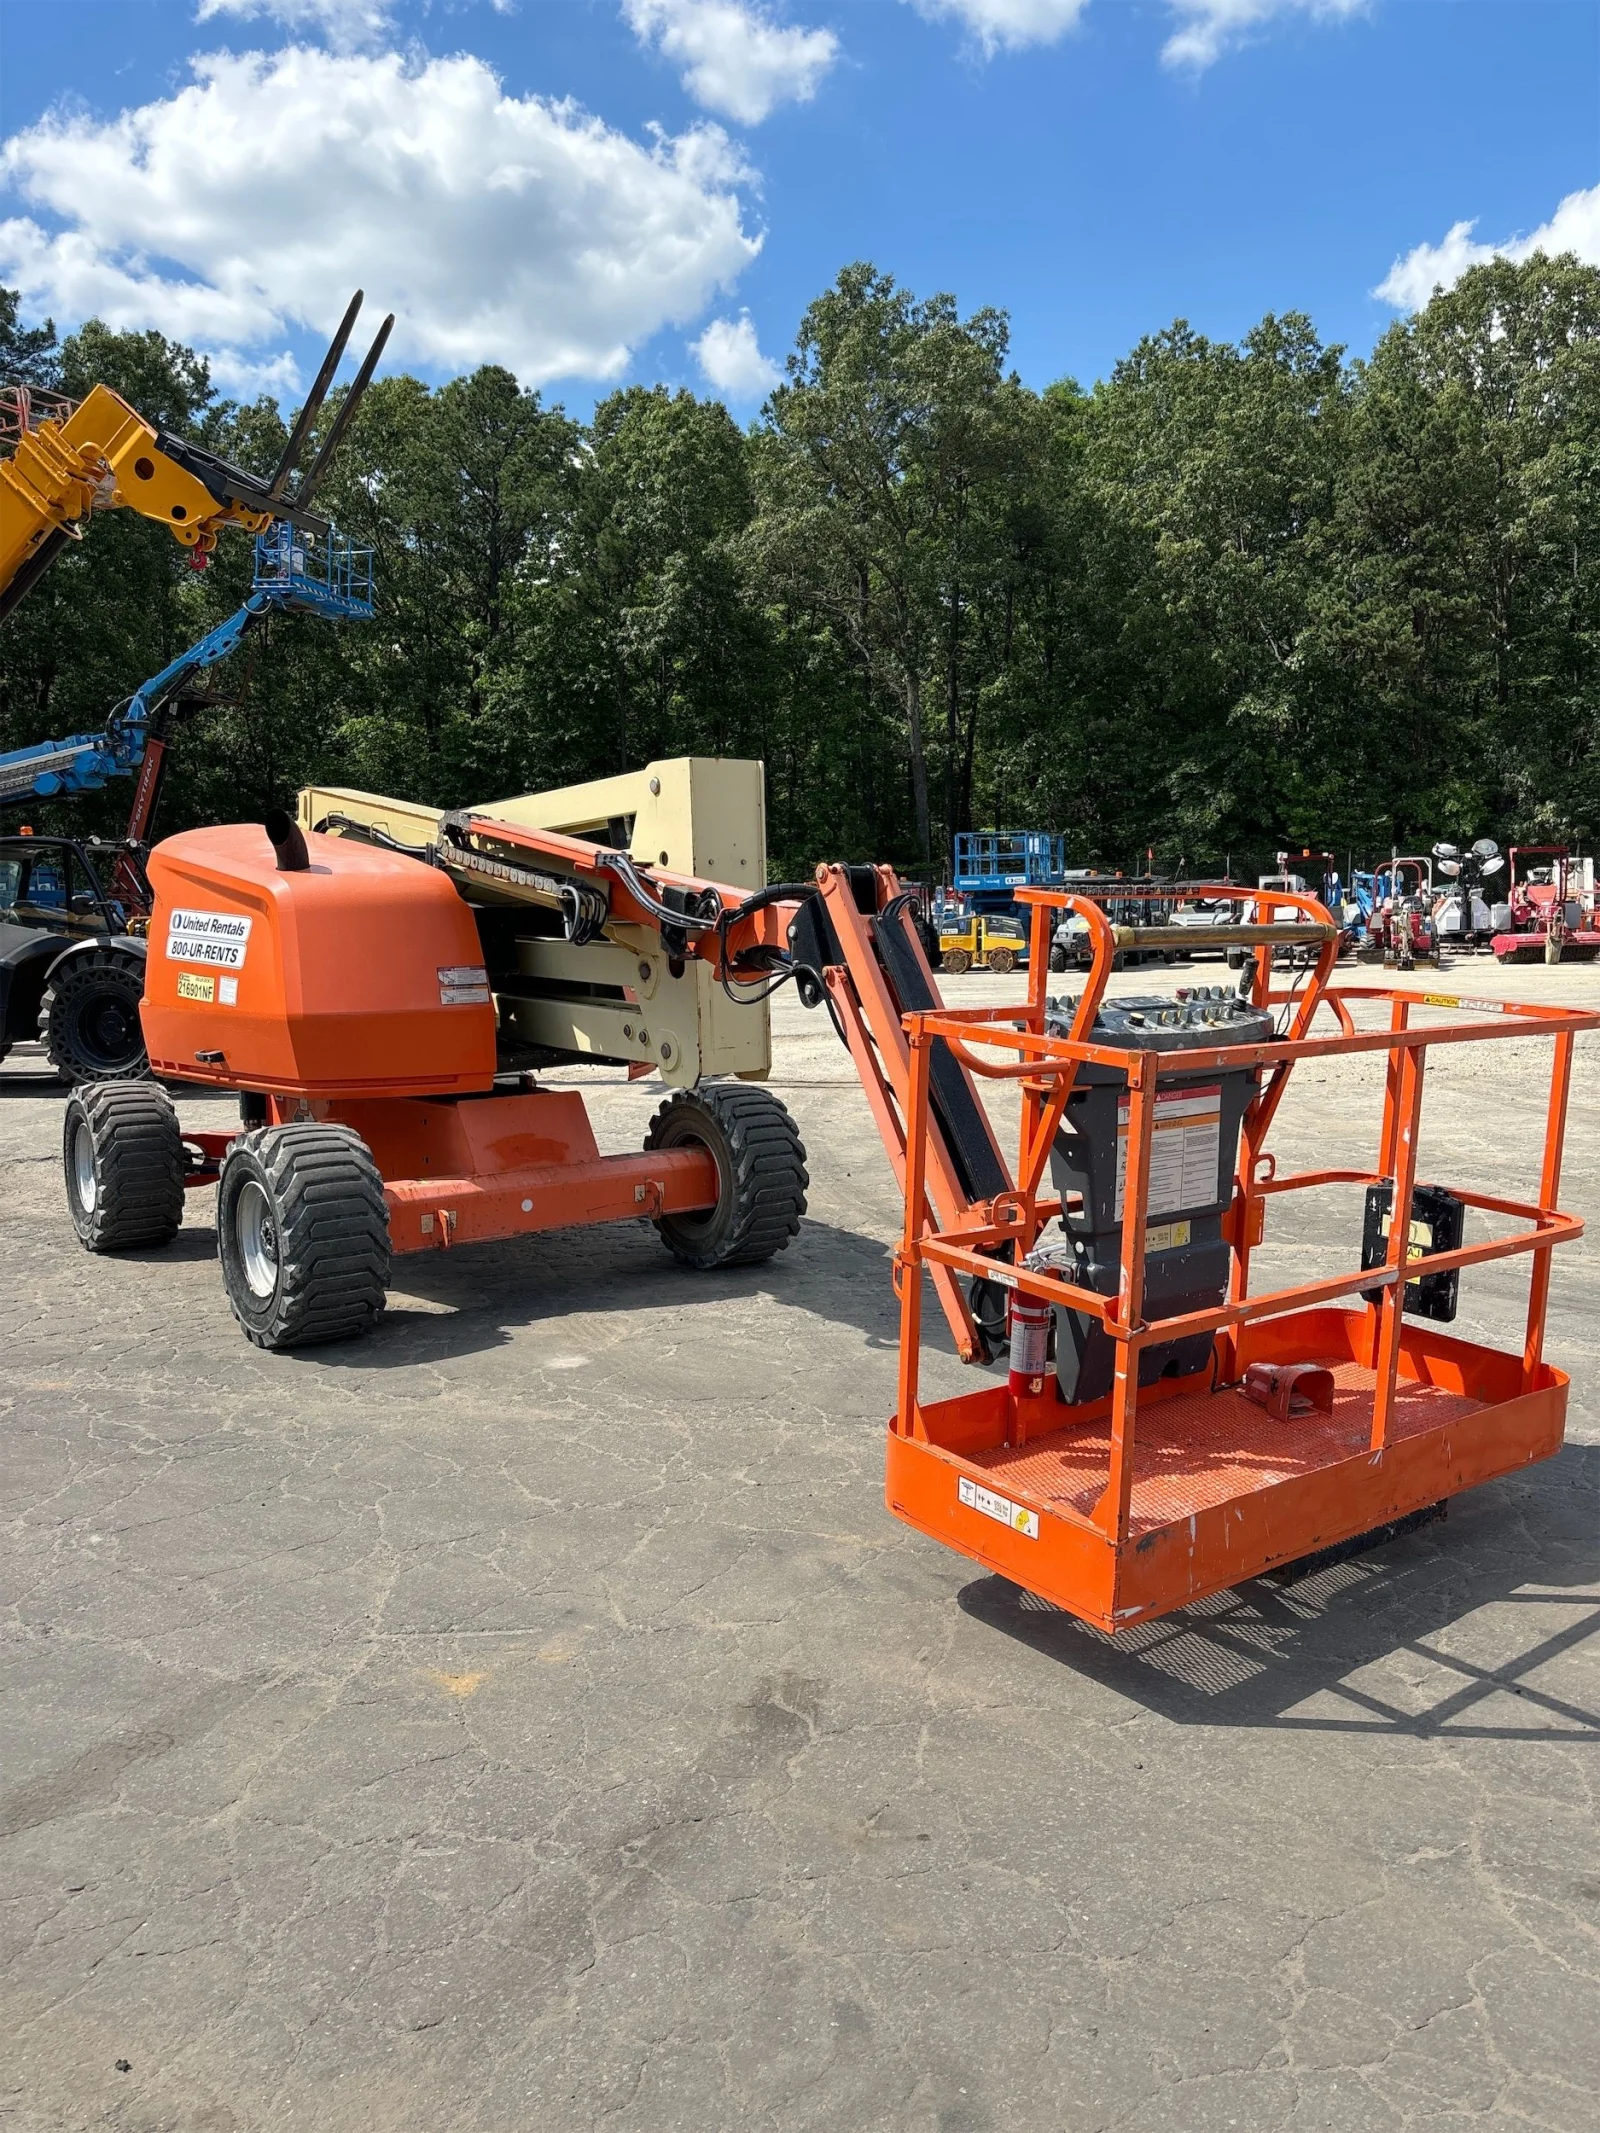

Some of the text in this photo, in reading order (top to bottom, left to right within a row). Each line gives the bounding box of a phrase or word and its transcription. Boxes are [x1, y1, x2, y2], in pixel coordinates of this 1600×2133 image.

[136, 757, 154, 821] SKYTRAK
[183, 915, 246, 937] United Rentals
[171, 941, 239, 963] 800-UR-RENTS
[1430, 997, 1458, 1006] CAUTION
[1161, 1091, 1184, 1101] DANGER
